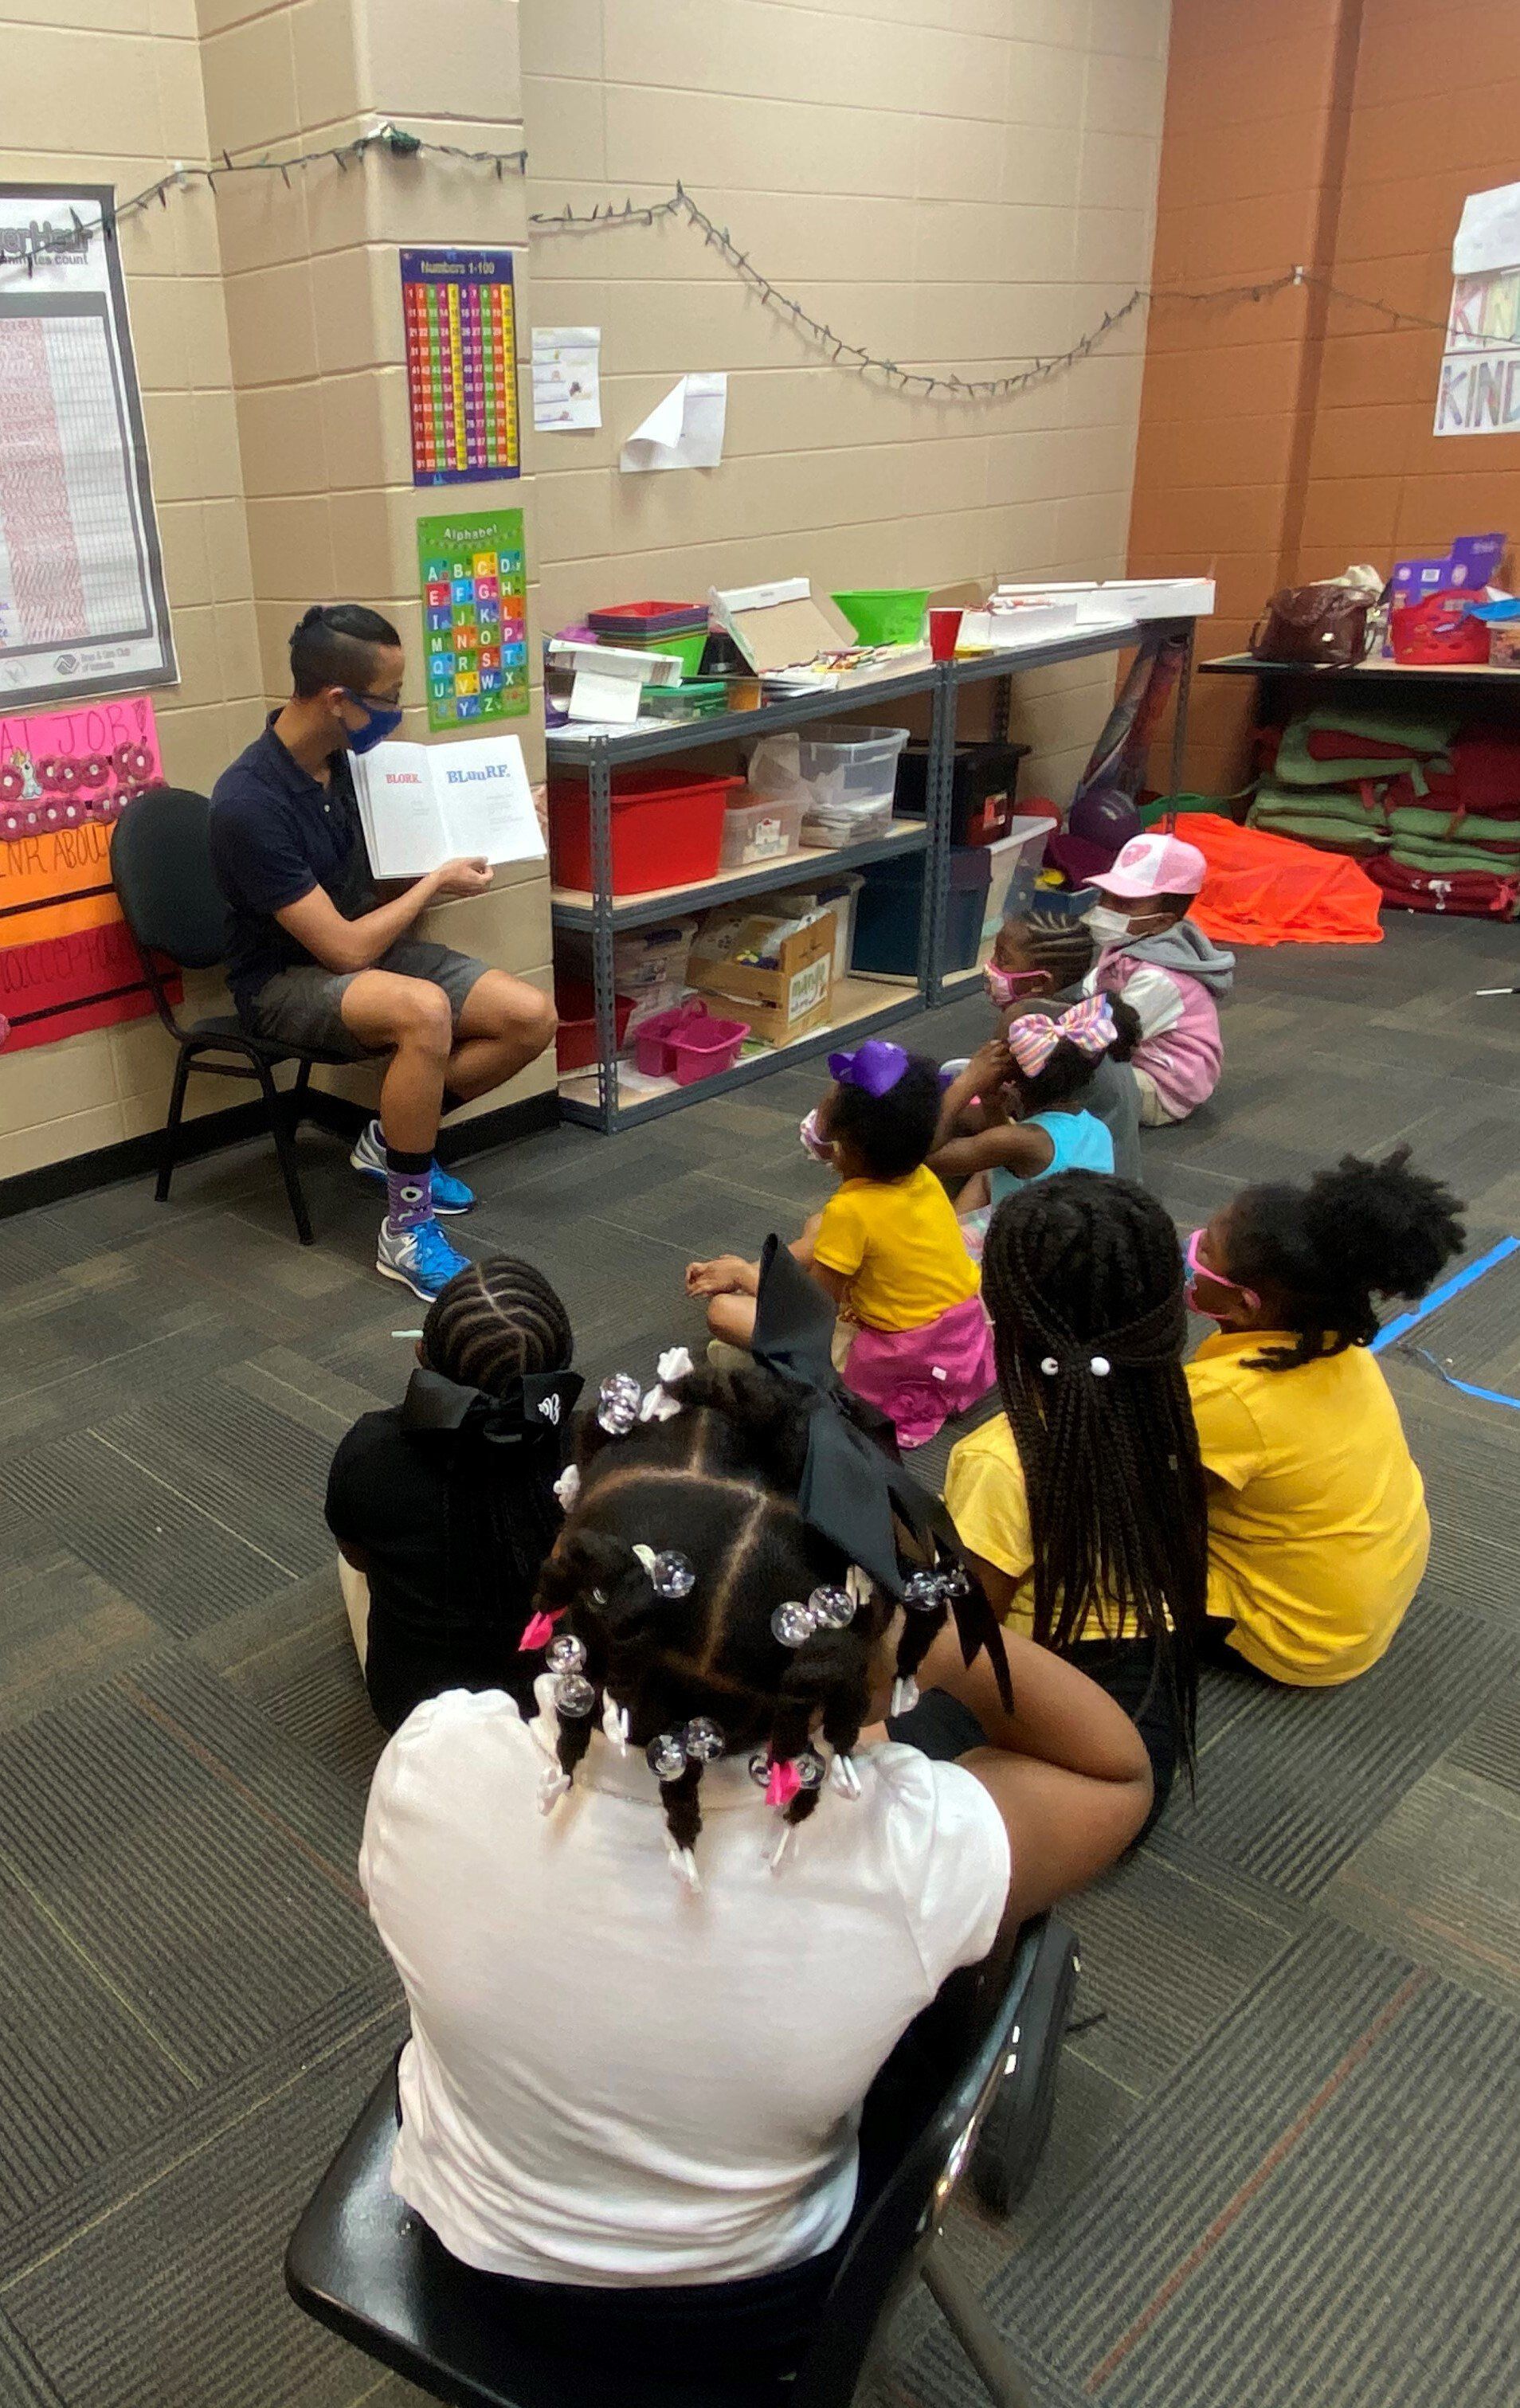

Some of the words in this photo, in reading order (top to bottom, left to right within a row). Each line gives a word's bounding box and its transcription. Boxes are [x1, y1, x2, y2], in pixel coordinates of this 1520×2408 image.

[421, 260, 465, 273] Numbers
[444, 523, 498, 542] Alphabet
[429, 566, 438, 581] A
[453, 563, 464, 578] B
[477, 561, 488, 575] C
[499, 558, 510, 573] D
[429, 590, 439, 605] E
[456, 587, 464, 601] F
[478, 584, 490, 599] G
[502, 581, 511, 596] H
[433, 614, 439, 630] I
[457, 612, 464, 626] J
[480, 609, 490, 624] K
[503, 606, 512, 621] L
[431, 637, 442, 652] M
[456, 634, 467, 650] N
[480, 630, 491, 644] O
[504, 628, 513, 641] P
[433, 660, 443, 675] Q
[459, 656, 468, 671] R
[482, 652, 491, 668] S
[505, 650, 514, 664] T
[434, 683, 444, 698] U
[481, 674, 494, 690] W
[505, 671, 514, 685] X
[459, 702, 468, 716] Y
[484, 697, 493, 712] Z
